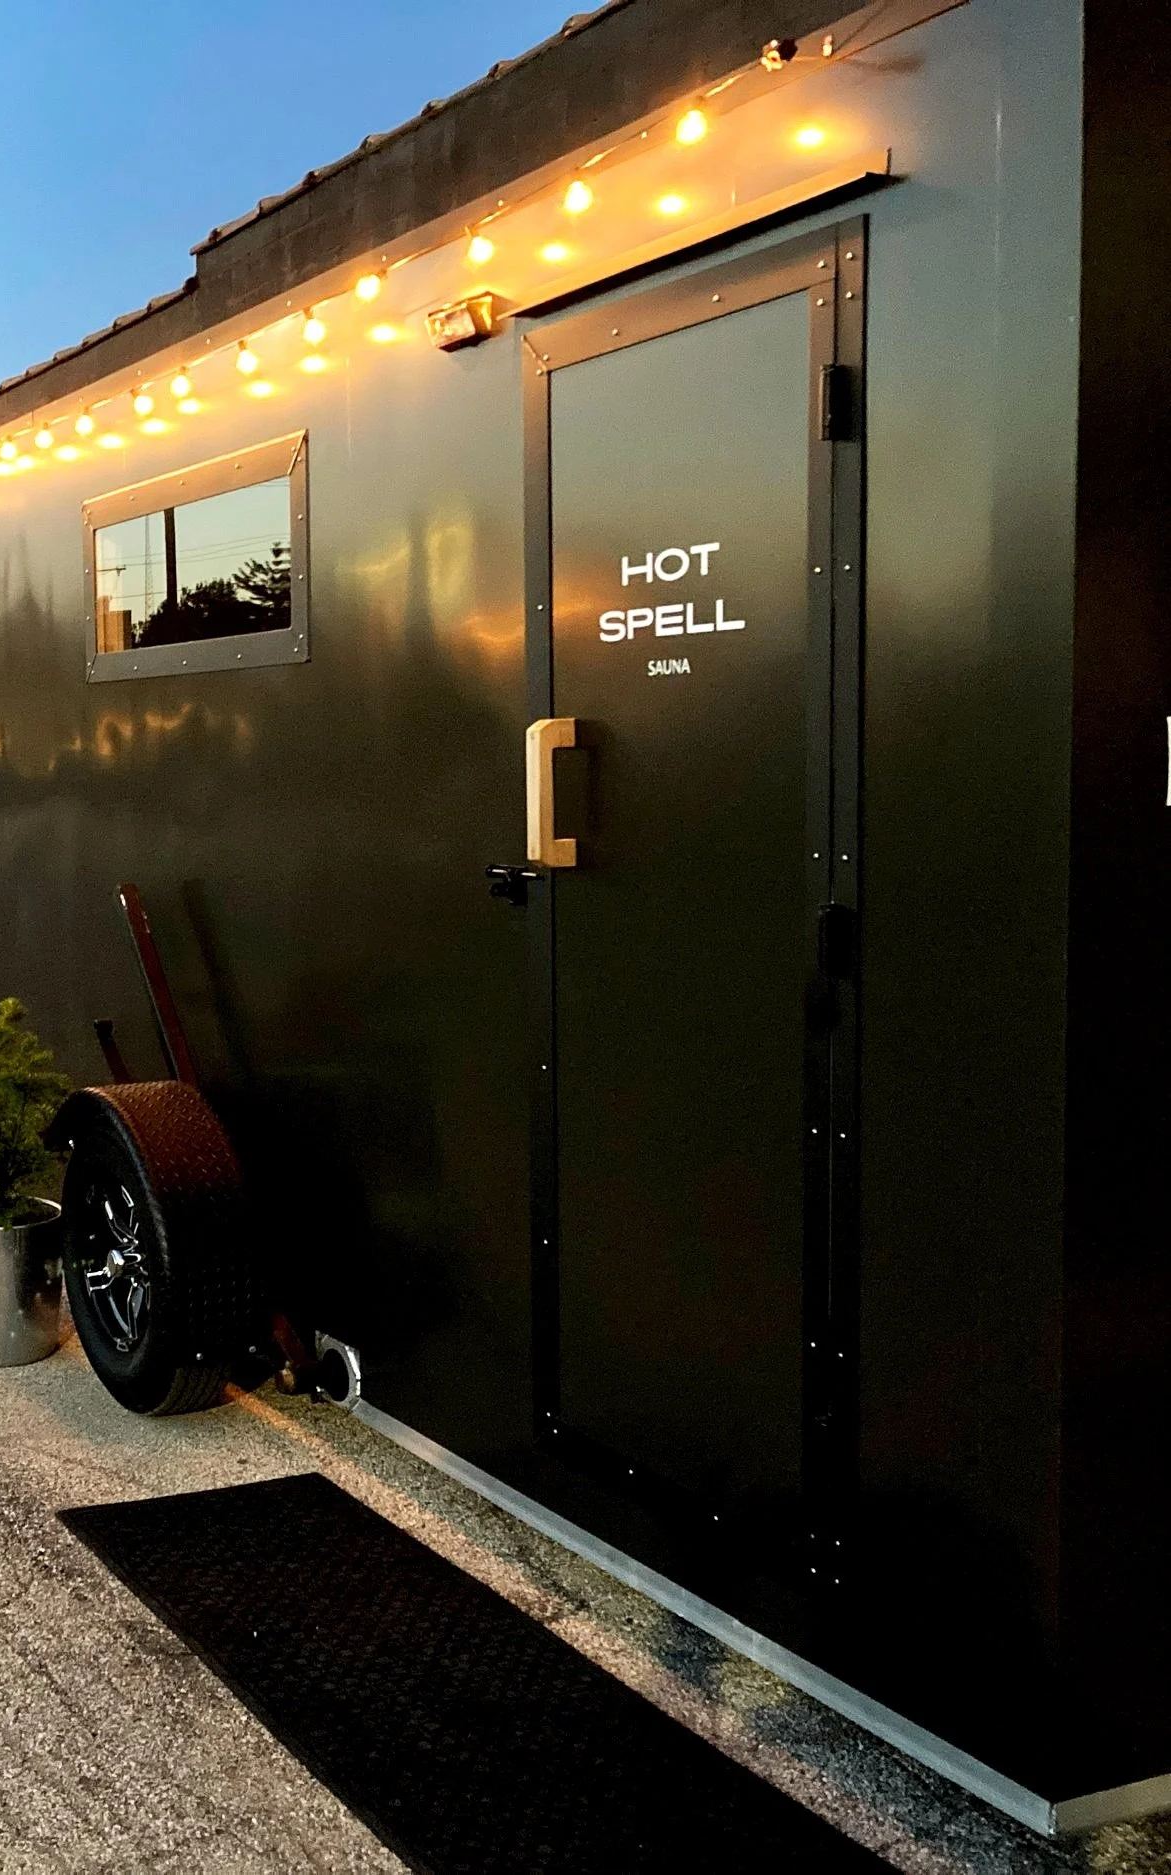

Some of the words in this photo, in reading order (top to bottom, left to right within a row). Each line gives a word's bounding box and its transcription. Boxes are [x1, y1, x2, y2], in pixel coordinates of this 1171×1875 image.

[621, 542, 721, 586] HOT
[599, 599, 746, 643] SPELL
[647, 658, 691, 677] SAUNA
